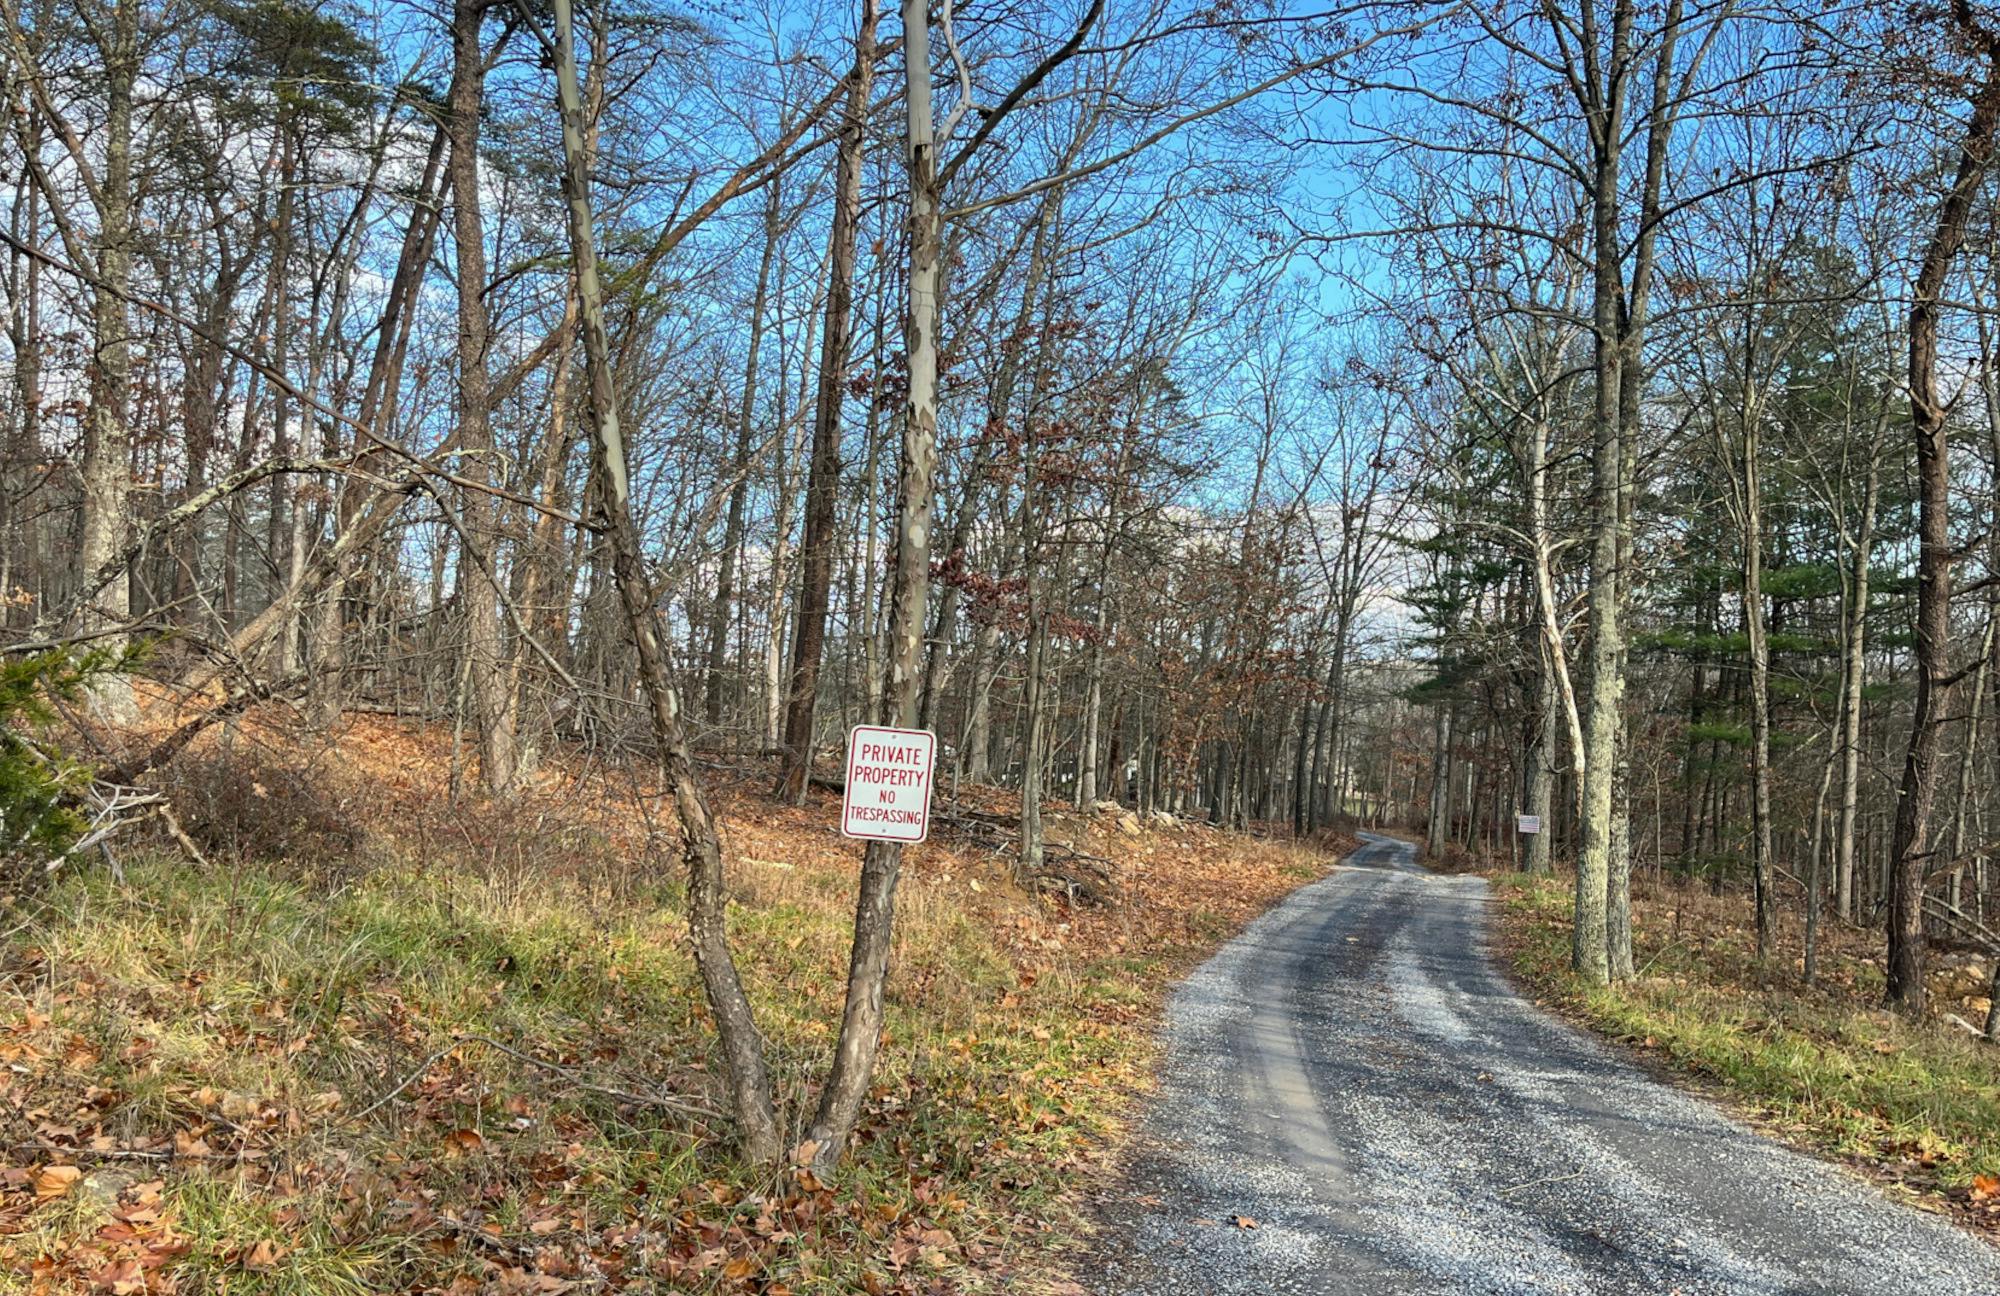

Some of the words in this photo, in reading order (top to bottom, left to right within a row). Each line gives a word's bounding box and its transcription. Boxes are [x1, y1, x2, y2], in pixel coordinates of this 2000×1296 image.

[861, 743, 922, 765] PRIVATE
[854, 765, 924, 787] PROPERTY
[879, 790, 896, 804] NO
[850, 806, 922, 825] TRESPASSING
